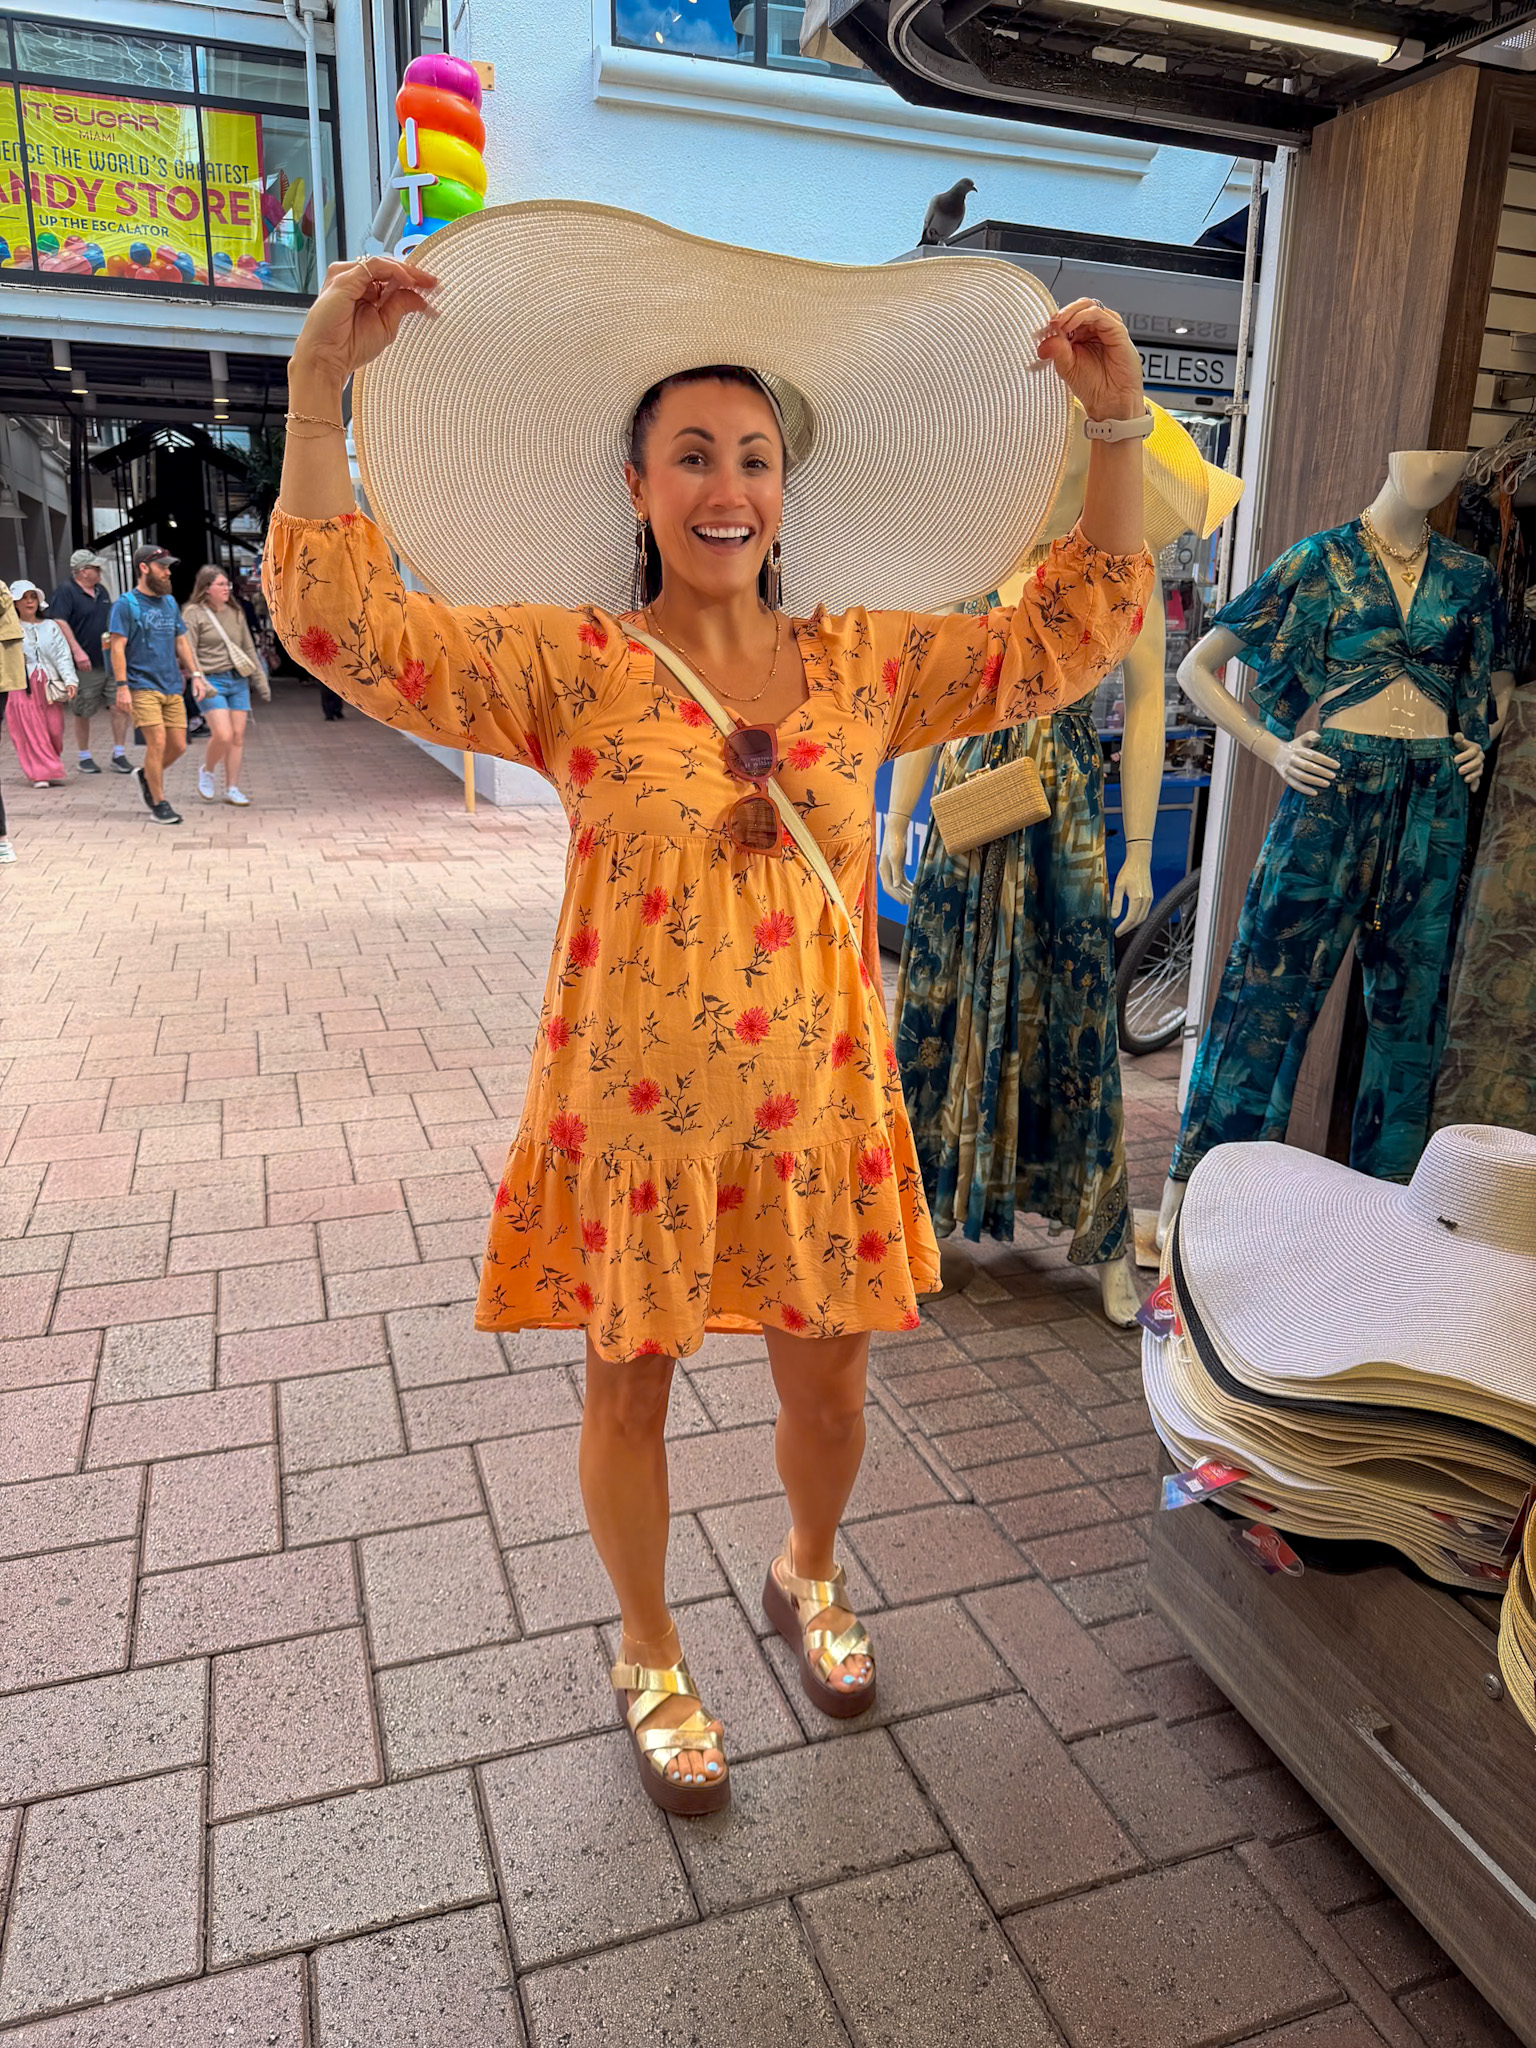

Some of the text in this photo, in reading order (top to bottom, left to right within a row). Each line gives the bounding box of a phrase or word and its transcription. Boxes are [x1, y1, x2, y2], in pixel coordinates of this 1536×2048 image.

[78, 129, 116, 143] MIAMI
[51, 145, 83, 170] THE
[88, 149, 168, 178] WORLD'S
[174, 159, 249, 185] GREATEST
[114, 180, 252, 227] STORE
[38, 214, 170, 238] UP THE ESCALATOR
